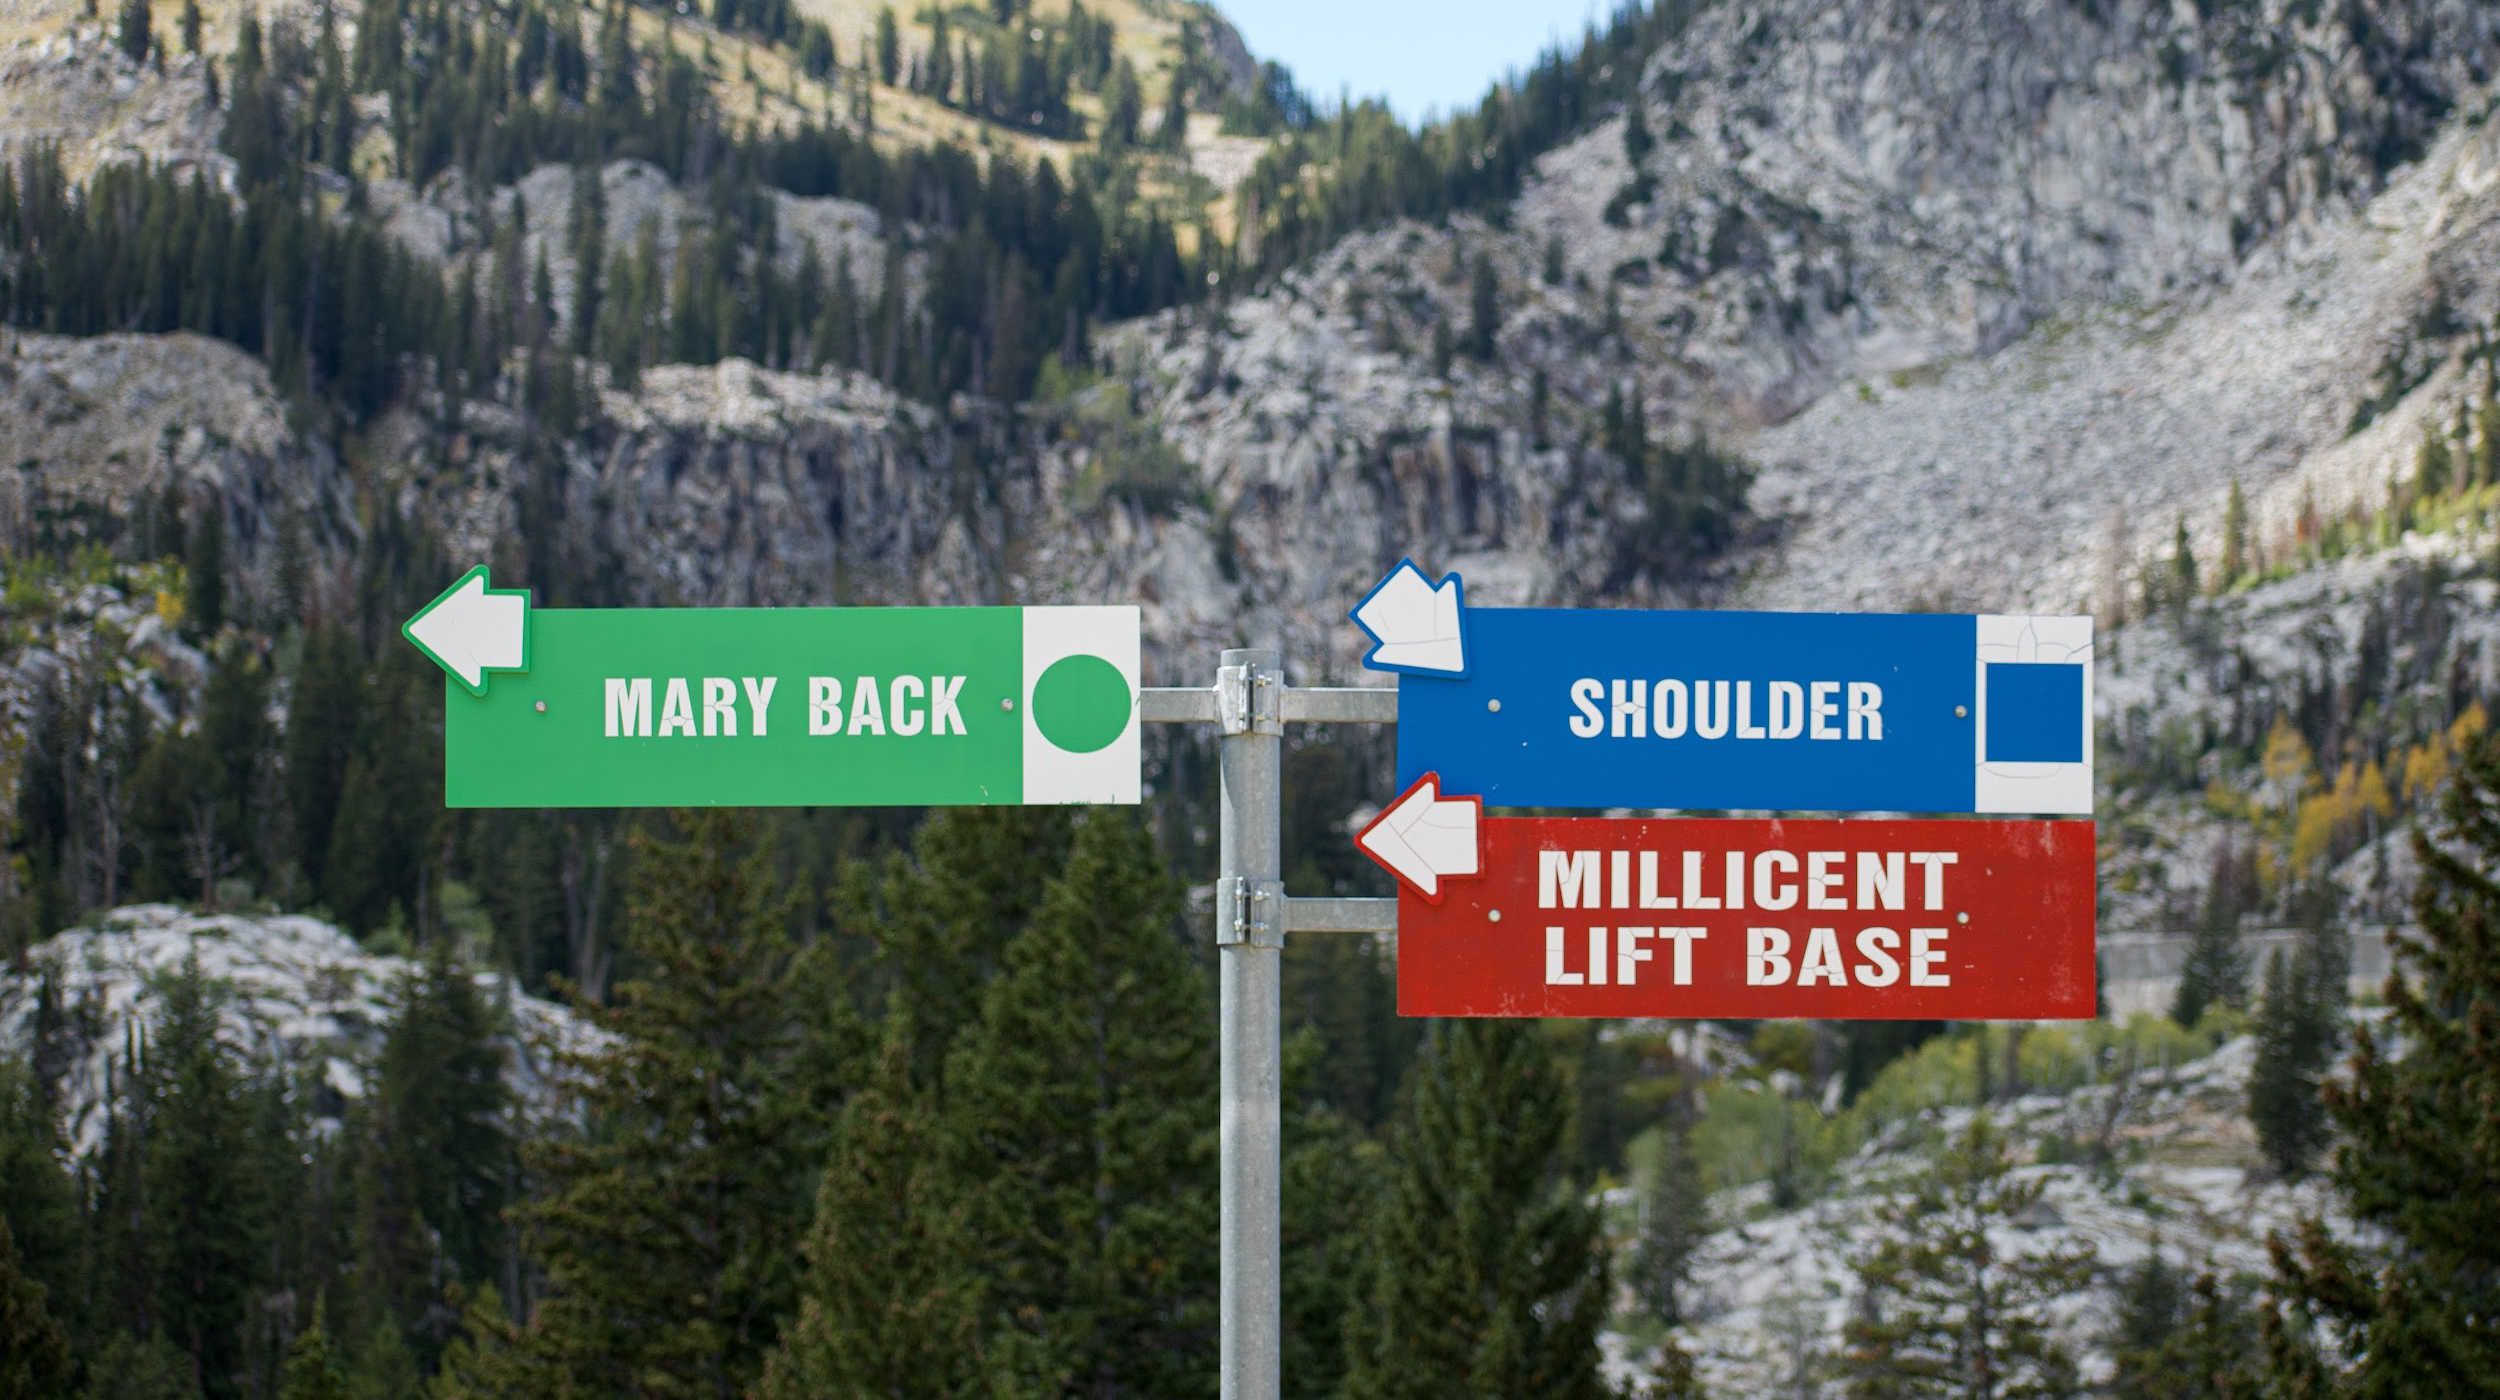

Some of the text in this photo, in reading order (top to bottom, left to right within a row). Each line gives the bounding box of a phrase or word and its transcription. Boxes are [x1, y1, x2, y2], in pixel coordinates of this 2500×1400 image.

[603, 675, 968, 738] MARY BACK
[1568, 678, 1883, 741] SHOULDER
[1538, 849, 1959, 911] MILLICENT
[1545, 926, 1951, 988] LIFT BASE
